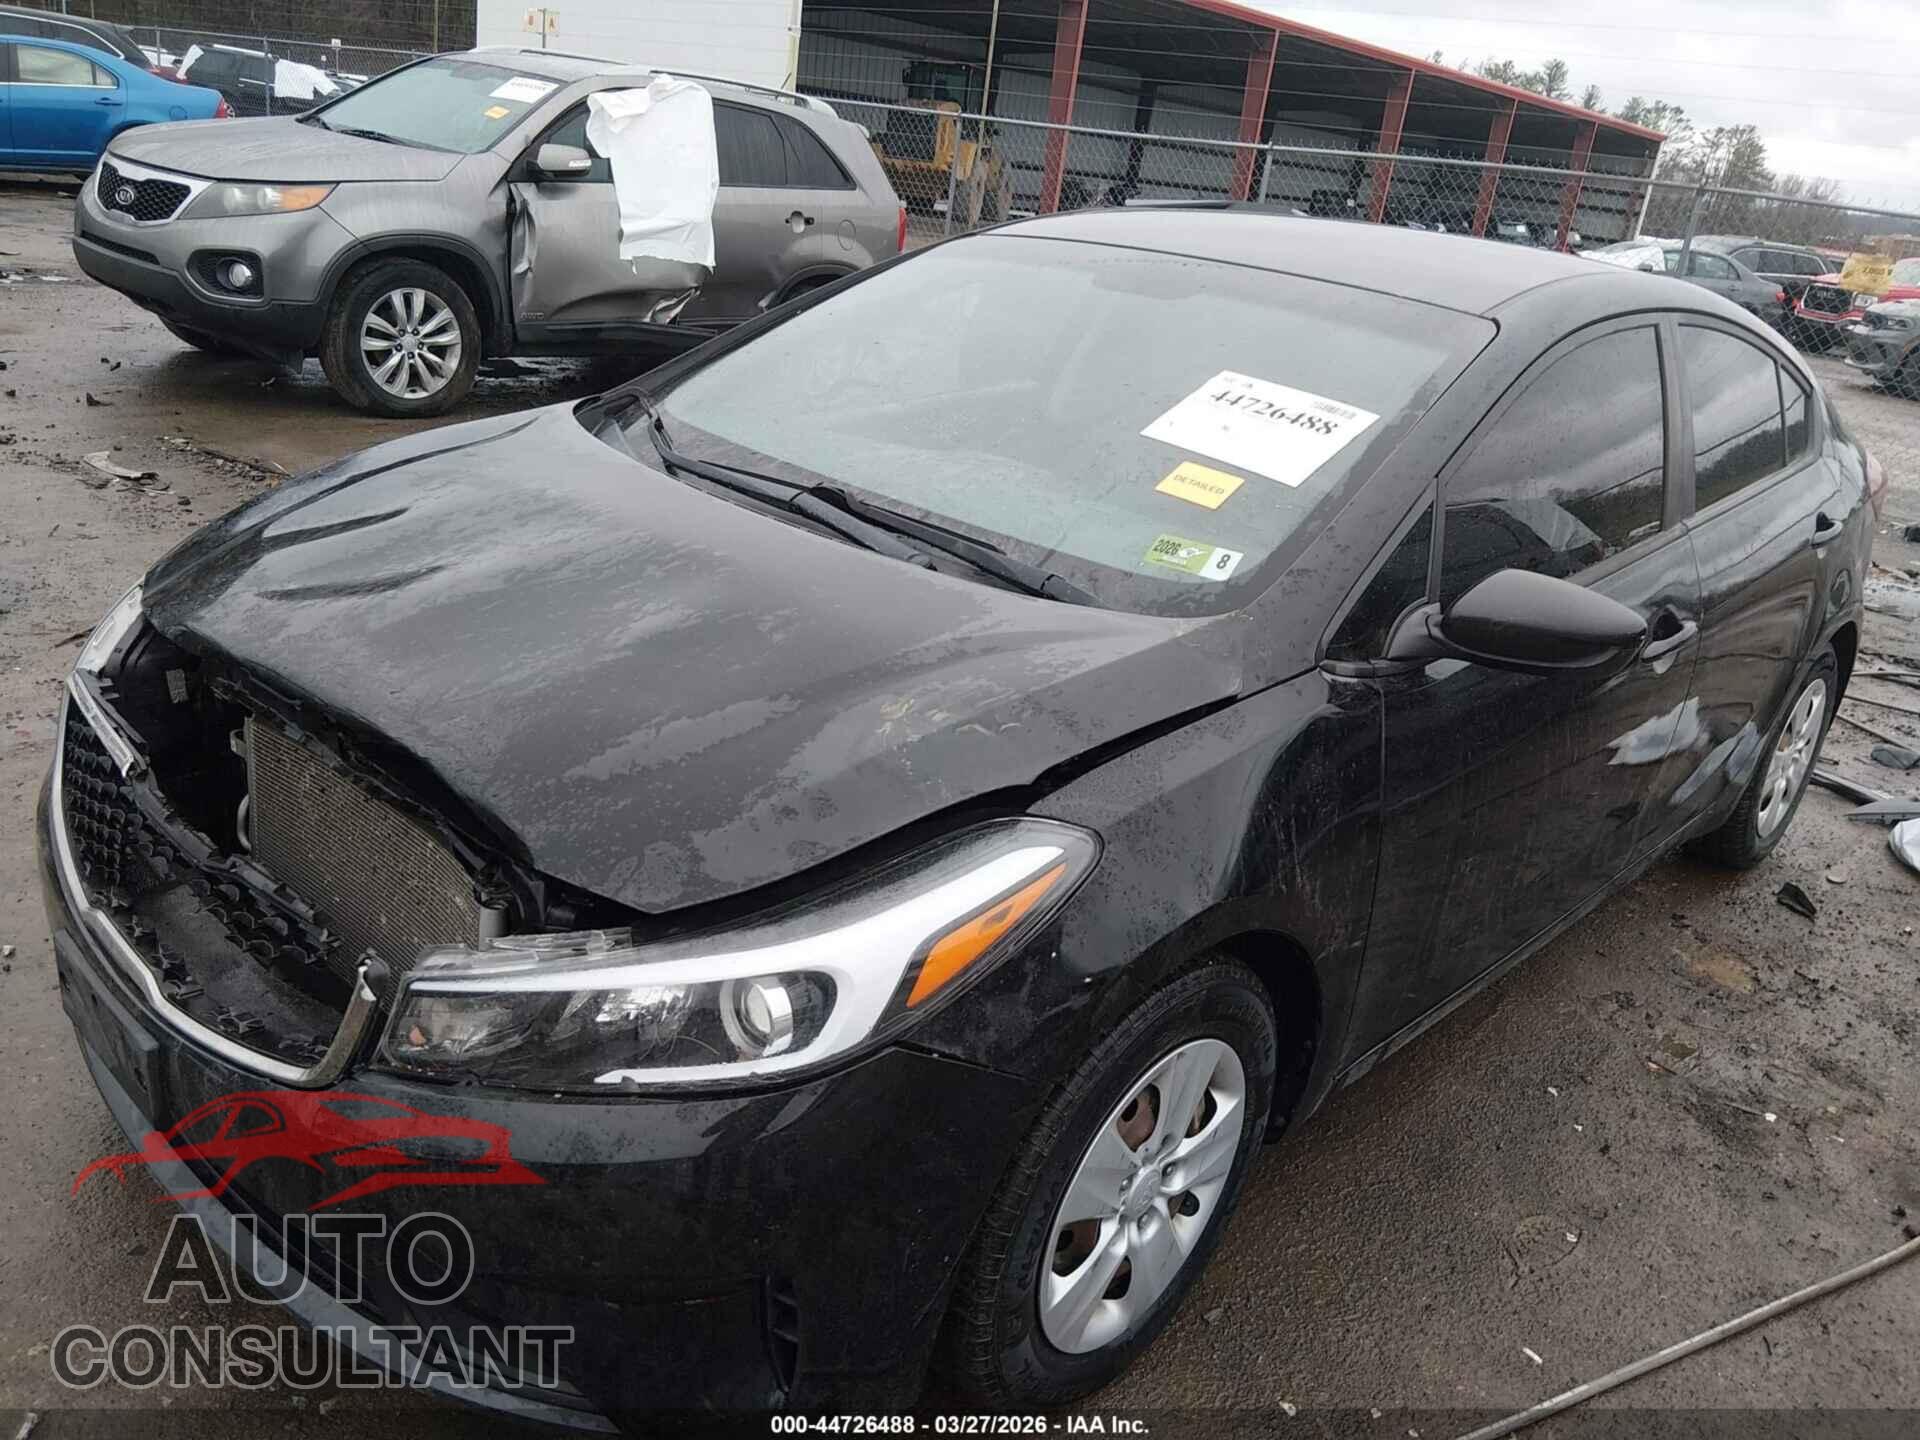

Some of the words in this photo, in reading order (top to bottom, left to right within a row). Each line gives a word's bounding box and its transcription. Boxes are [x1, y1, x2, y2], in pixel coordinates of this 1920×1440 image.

[1210, 390, 1339, 435] 44726488
[1173, 474, 1225, 495] DETAILED
[1216, 554, 1231, 570] 8
